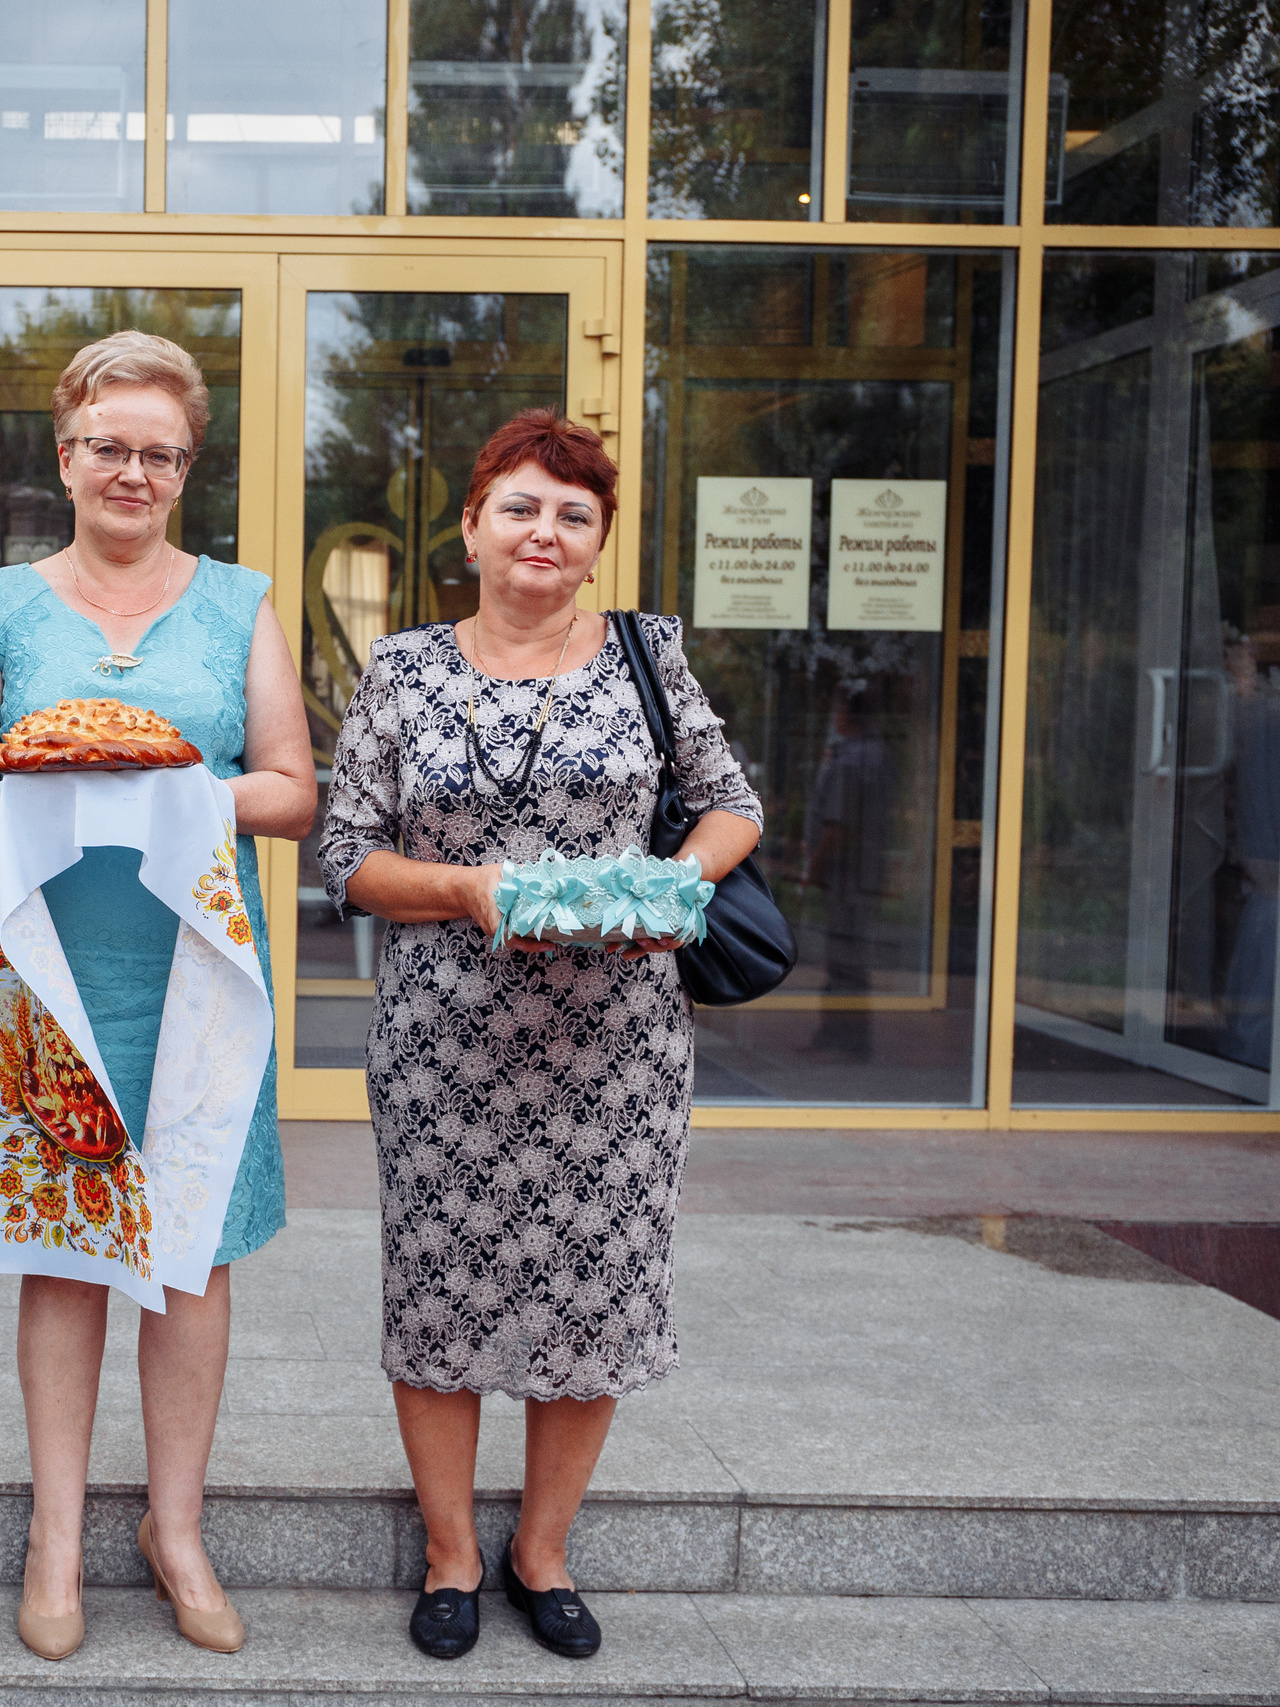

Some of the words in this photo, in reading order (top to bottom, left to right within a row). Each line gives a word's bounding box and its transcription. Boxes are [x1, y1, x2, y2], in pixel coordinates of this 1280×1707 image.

[704, 532, 749, 549] Режим
[750, 532, 802, 554] работы
[838, 535, 883, 552] Режим
[885, 535, 937, 556] работы
[718, 560, 748, 570] 11.00
[750, 559, 763, 570] до
[765, 560, 795, 571] 24.00
[852, 562, 882, 572] 11.00
[884, 561, 897, 572] до
[899, 562, 930, 573] 24.00
